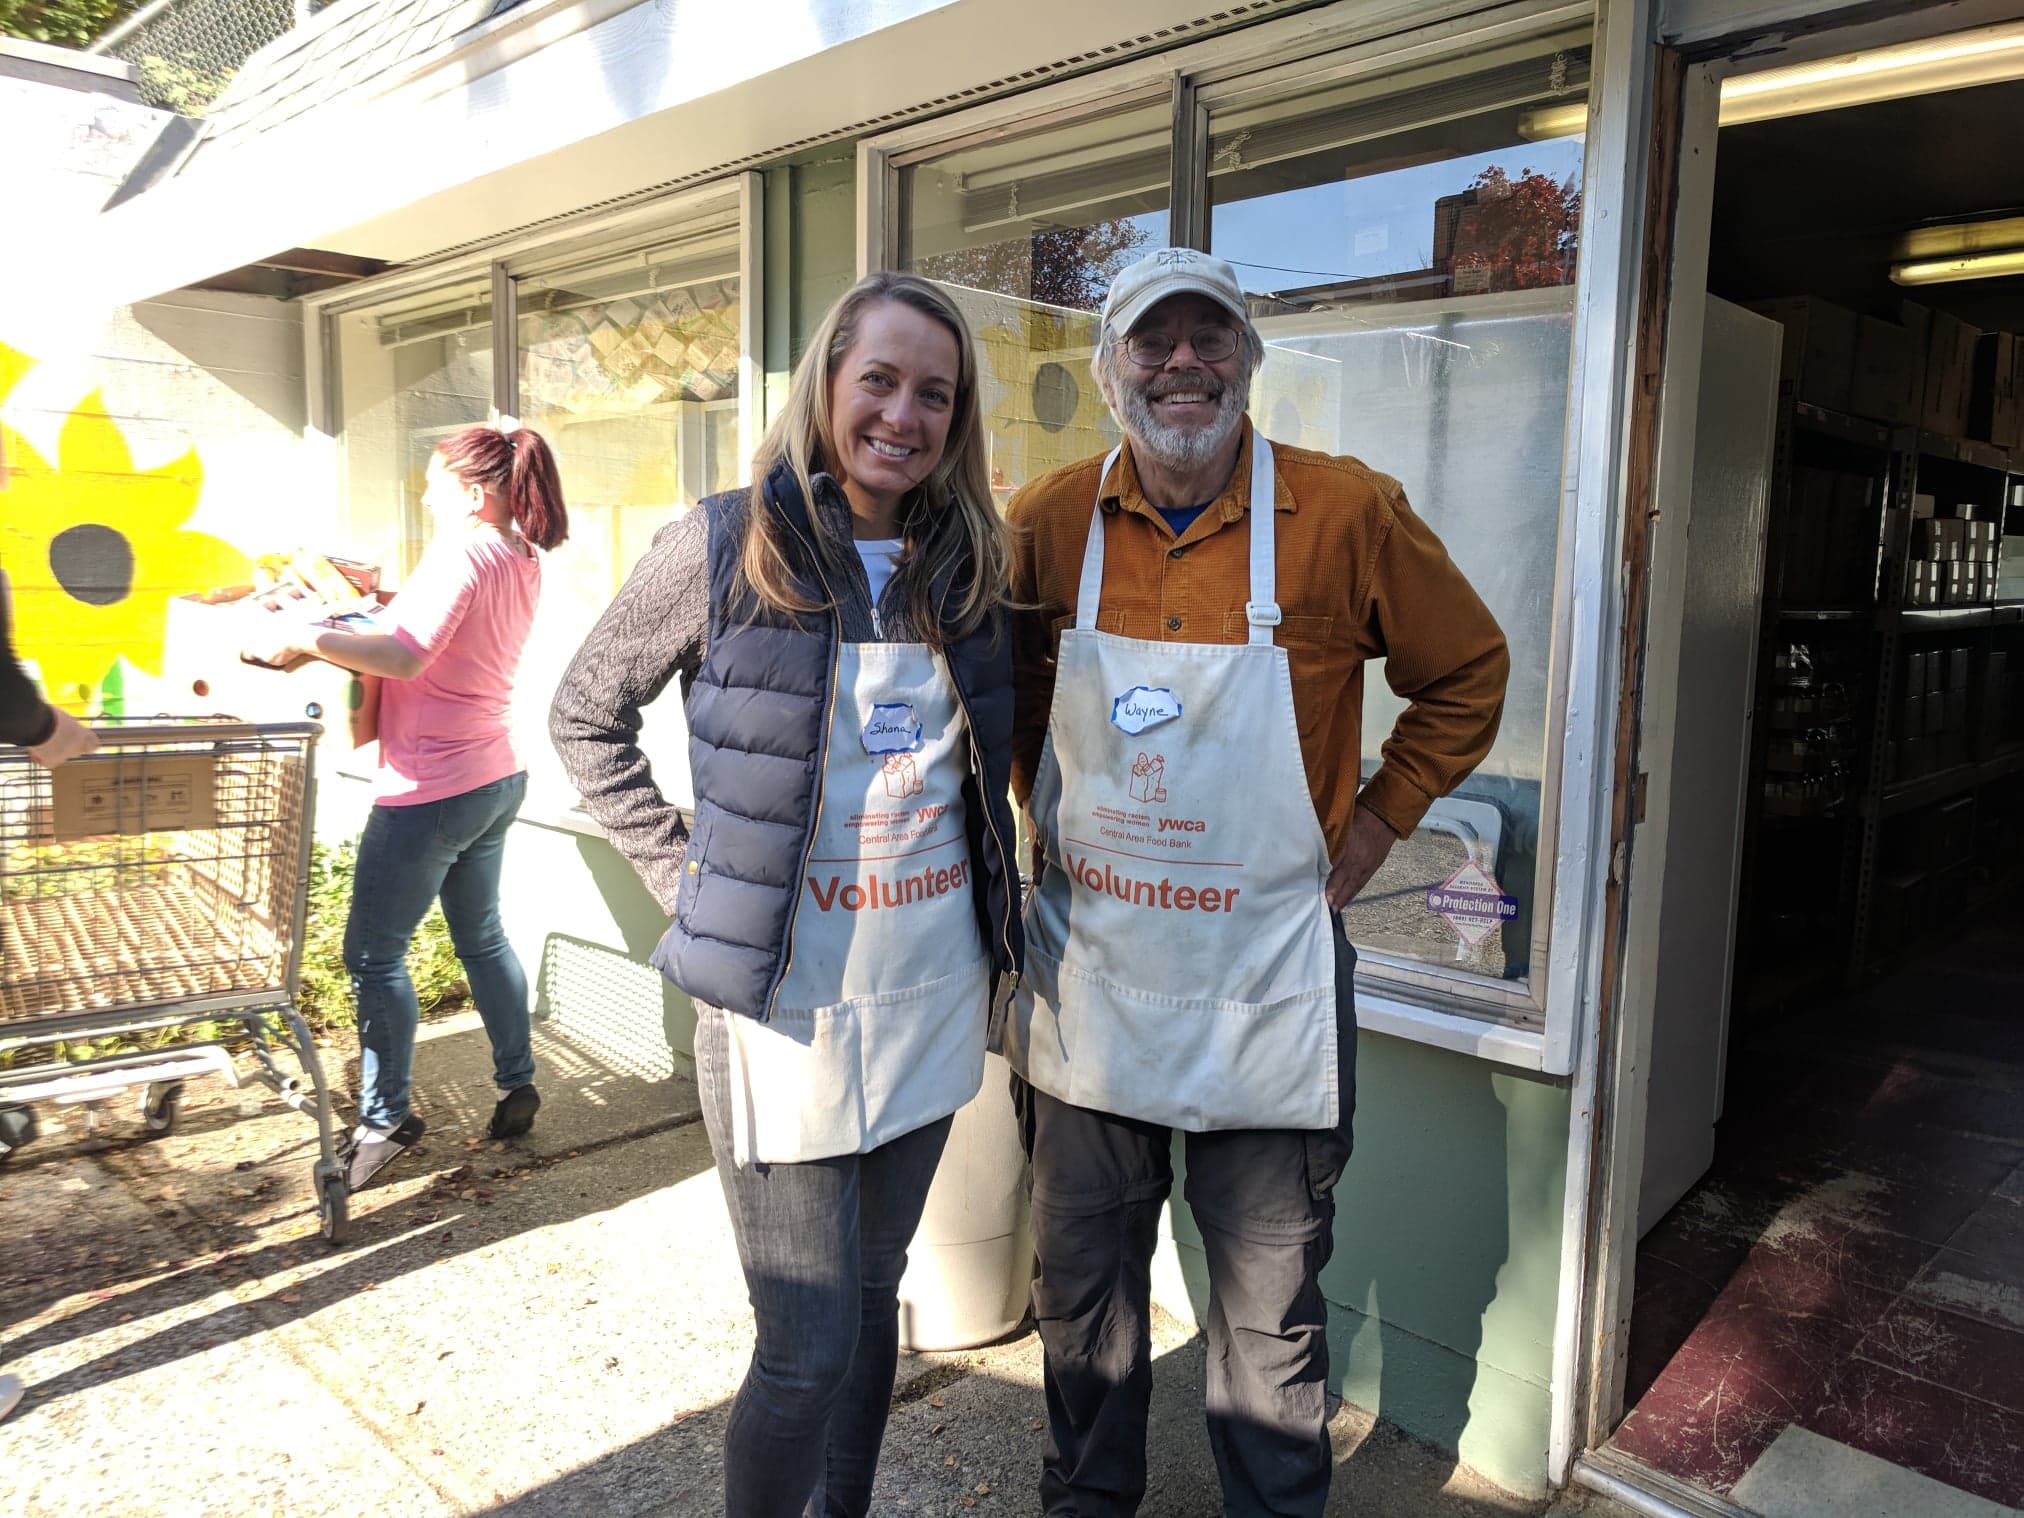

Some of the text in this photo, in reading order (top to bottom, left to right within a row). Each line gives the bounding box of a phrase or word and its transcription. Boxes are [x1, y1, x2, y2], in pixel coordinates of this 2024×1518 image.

[1125, 703, 1169, 722] Wayne
[870, 721, 911, 735] Shana
[844, 819, 889, 829] empowering
[850, 811, 889, 821] eliminating
[1158, 817, 1206, 832] ywca
[859, 833, 890, 845] Central
[891, 833, 909, 842] Area
[1100, 826, 1192, 848] Central Area Food Bank
[808, 858, 969, 912] Volunteer
[1066, 853, 1241, 913] Volunteer
[1442, 894, 1517, 915] Protection One
